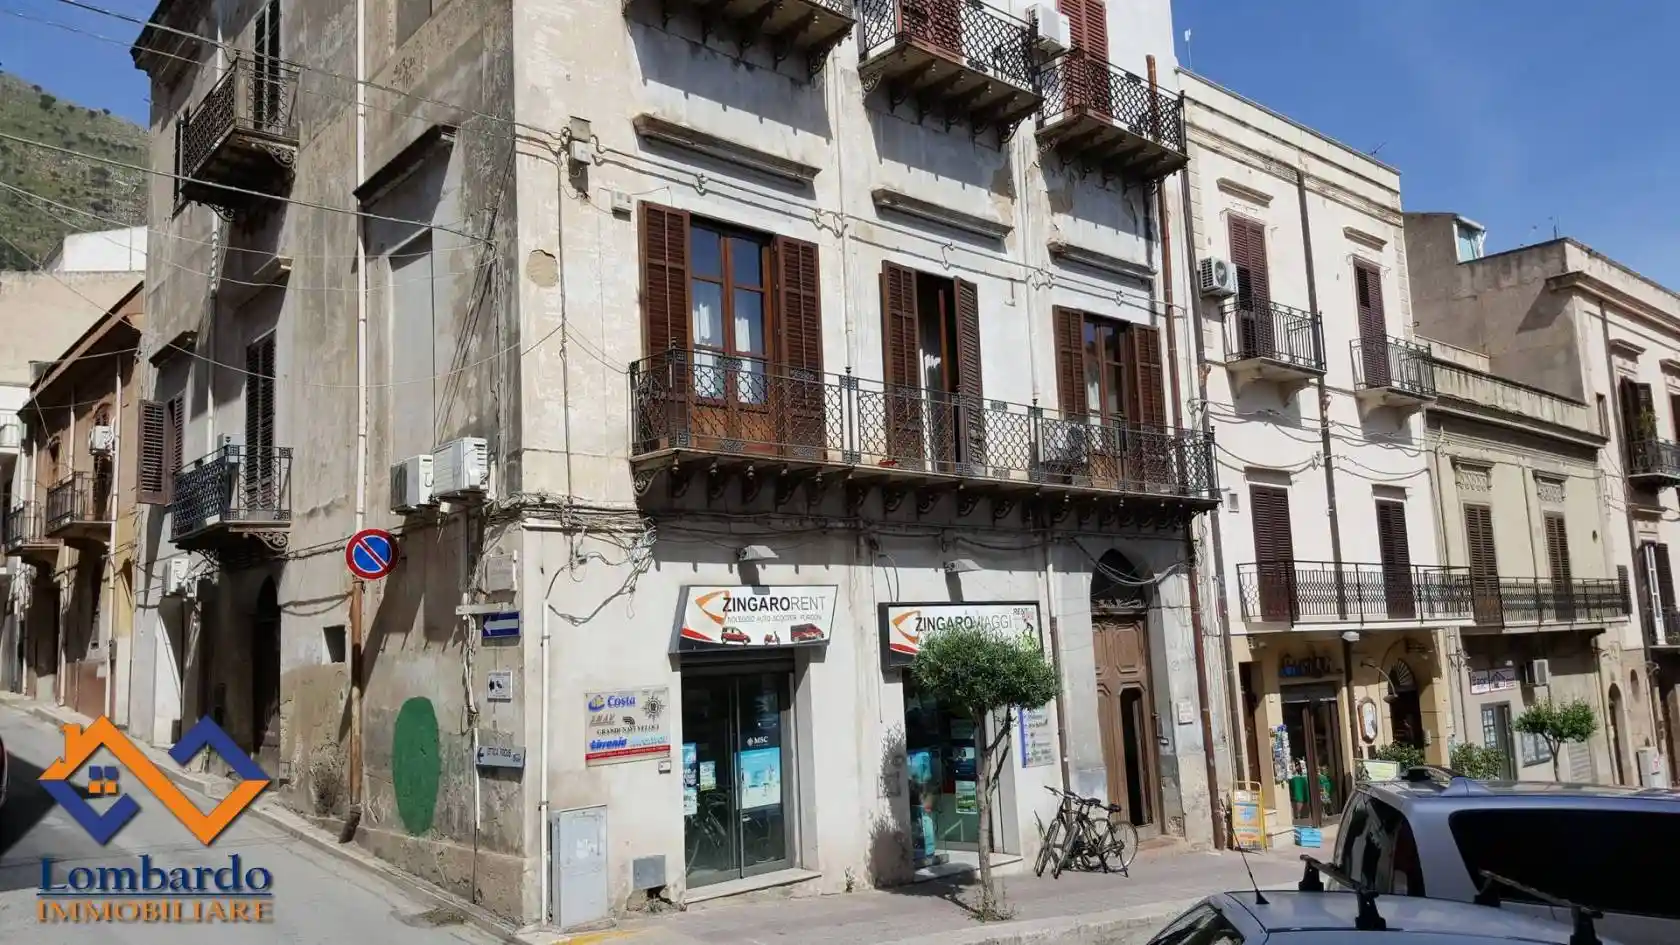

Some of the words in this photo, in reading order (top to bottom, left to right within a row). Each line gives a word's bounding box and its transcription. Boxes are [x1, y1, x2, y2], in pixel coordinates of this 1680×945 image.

[722, 596, 826, 612] ZINGARORENT
[607, 695, 636, 708] Costa
[753, 736, 769, 744] MSC
